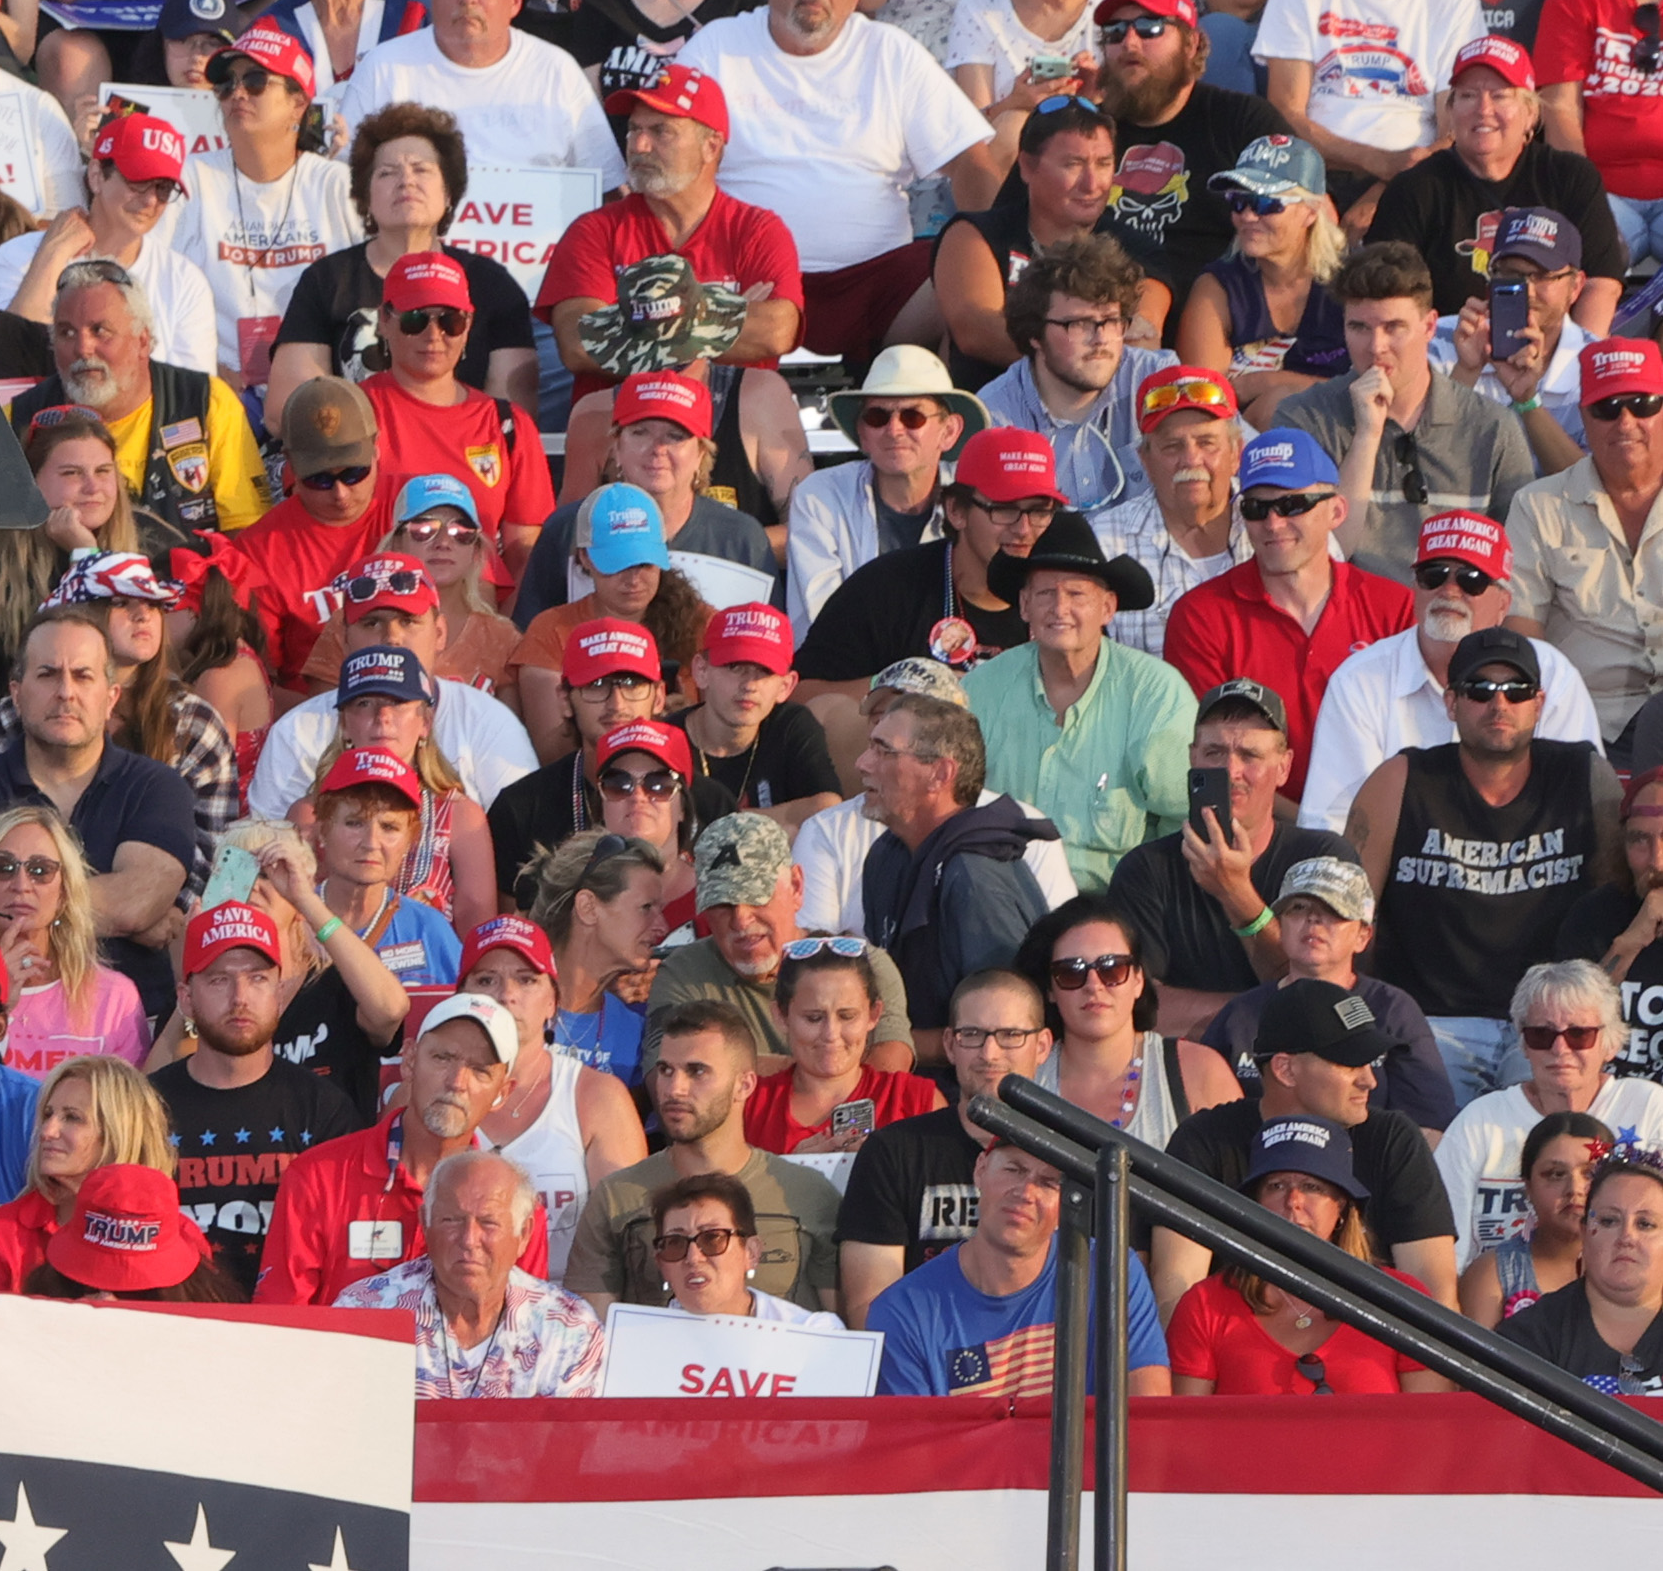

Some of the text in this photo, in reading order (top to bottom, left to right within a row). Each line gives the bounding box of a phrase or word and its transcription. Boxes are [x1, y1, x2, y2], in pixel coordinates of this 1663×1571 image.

[98, 137, 115, 154] 45
[141, 127, 183, 164] USA
[223, 230, 320, 249] AMERICANS
[263, 247, 323, 268] TRUMP
[631, 295, 682, 314] Trump
[1592, 350, 1645, 366] Trump
[1247, 442, 1293, 461] Trump
[1422, 517, 1498, 543] MAKE AMERICA
[1426, 533, 1492, 558] GREAT AGAIN
[364, 560, 404, 573] KEEP
[725, 610, 781, 632] TRUMP
[580, 633, 608, 649] MAKE
[588, 643, 620, 657] GREAT
[347, 653, 405, 674] TRUMP
[355, 750, 407, 777] Trump
[368, 765, 395, 779] 2024
[1420, 829, 1564, 868] AMERICAN
[1395, 855, 1584, 895] SUPREMACIST
[213, 907, 255, 926] SAVE
[201, 923, 272, 949] AMERICA
[1261, 1121, 1331, 1141] MAKE AMERICA
[1264, 1132, 1327, 1149] GREAT AGAIN
[85, 1214, 160, 1245] TRUMP
[99, 1236, 132, 1251] AMERICA
[678, 1363, 797, 1398] SAVE
